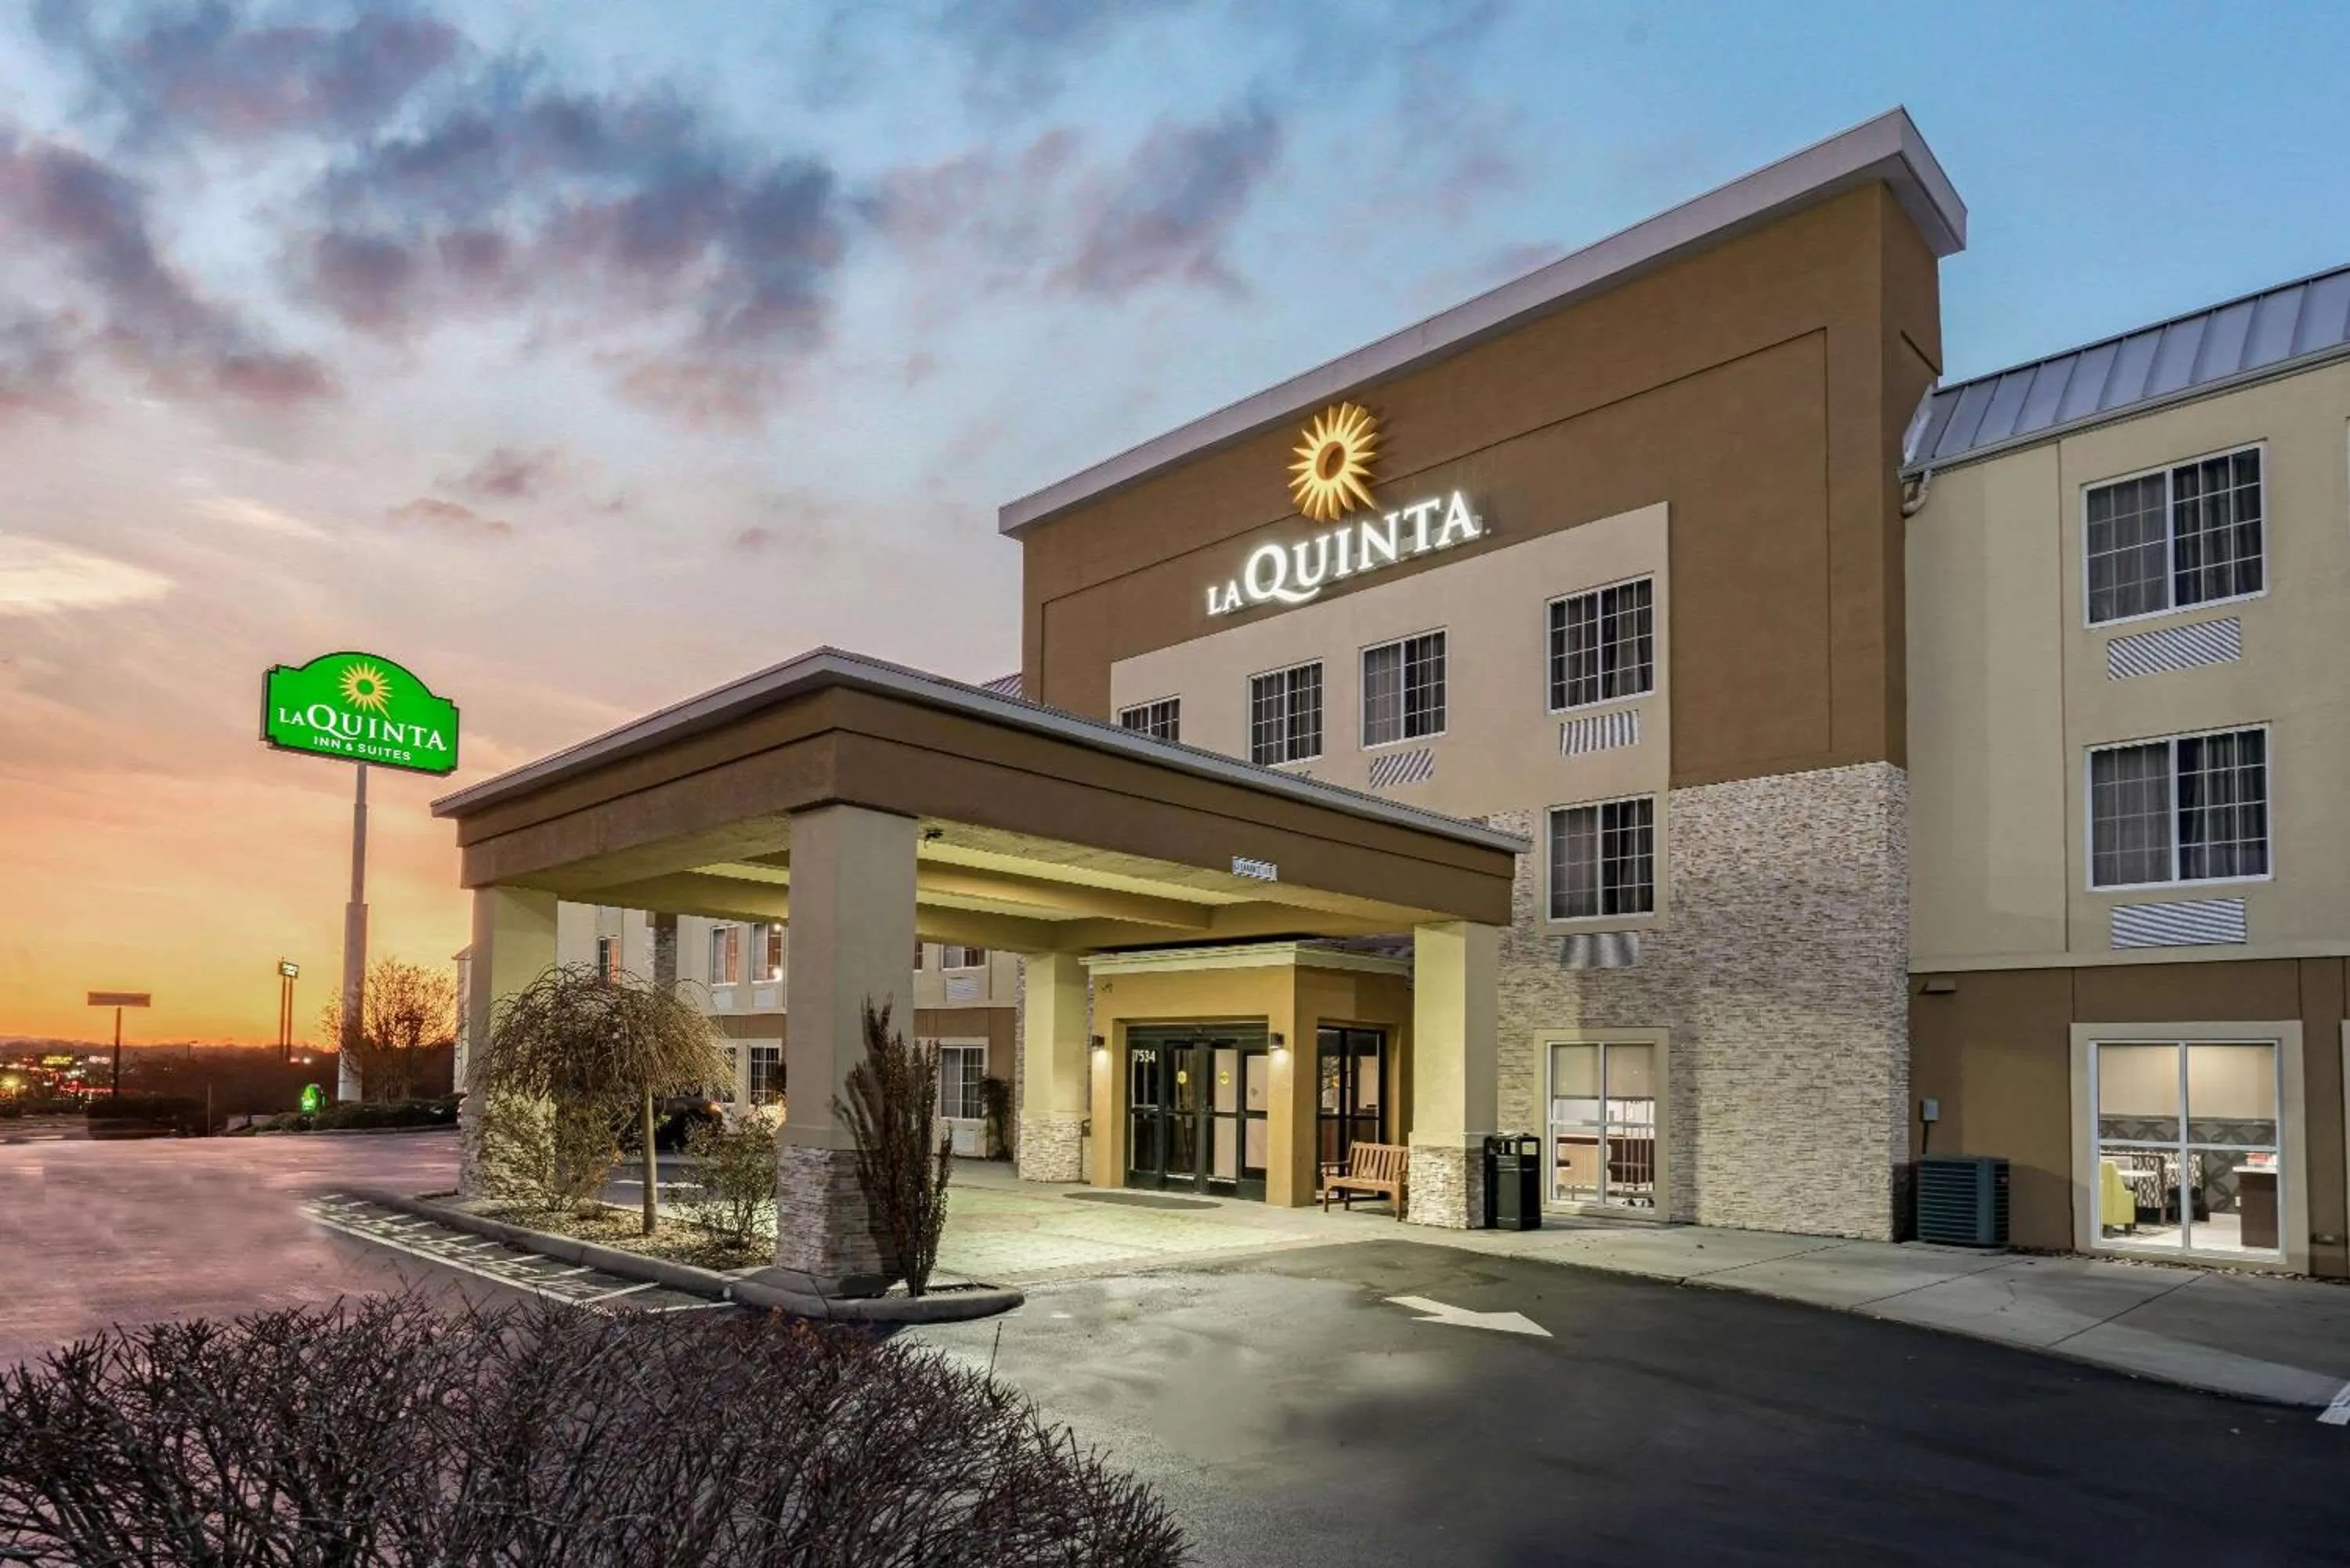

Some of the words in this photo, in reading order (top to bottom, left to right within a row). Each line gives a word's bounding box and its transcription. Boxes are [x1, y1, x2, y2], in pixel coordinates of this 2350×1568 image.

[1207, 580, 1243, 615] LA
[1244, 490, 1481, 602] QUINTA
[279, 707, 306, 726] LA
[306, 703, 447, 751] QUINTA
[314, 735, 341, 750] INN
[345, 742, 353, 752] &
[357, 742, 412, 761] SUITES
[1133, 1050, 1155, 1063] 7534
